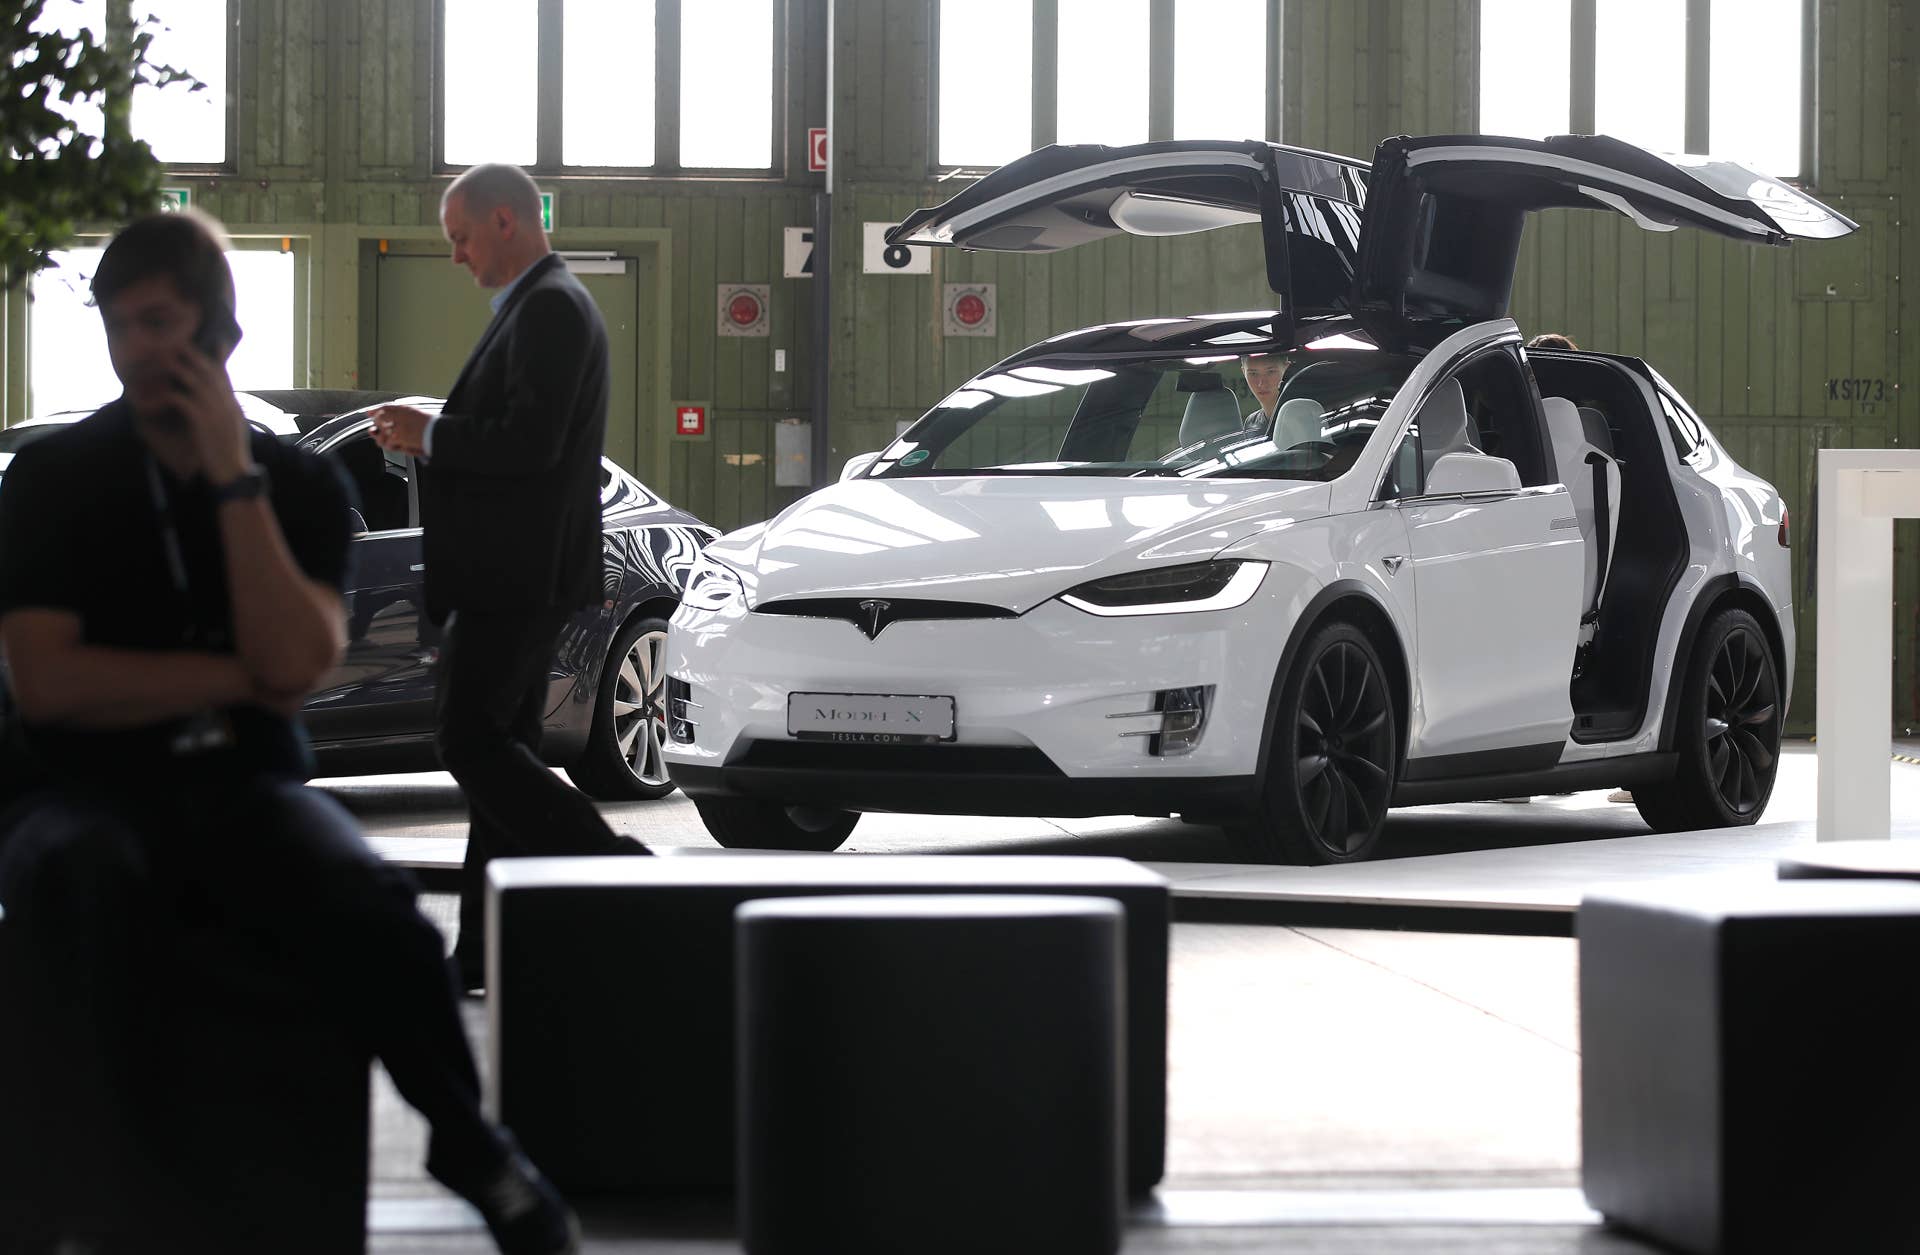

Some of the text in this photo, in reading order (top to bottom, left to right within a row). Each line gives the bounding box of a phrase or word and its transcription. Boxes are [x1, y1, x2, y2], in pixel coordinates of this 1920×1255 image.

[1829, 378, 1884, 401] KS173
[905, 710, 922, 722] X
[831, 732, 900, 743] TESLA.COM
